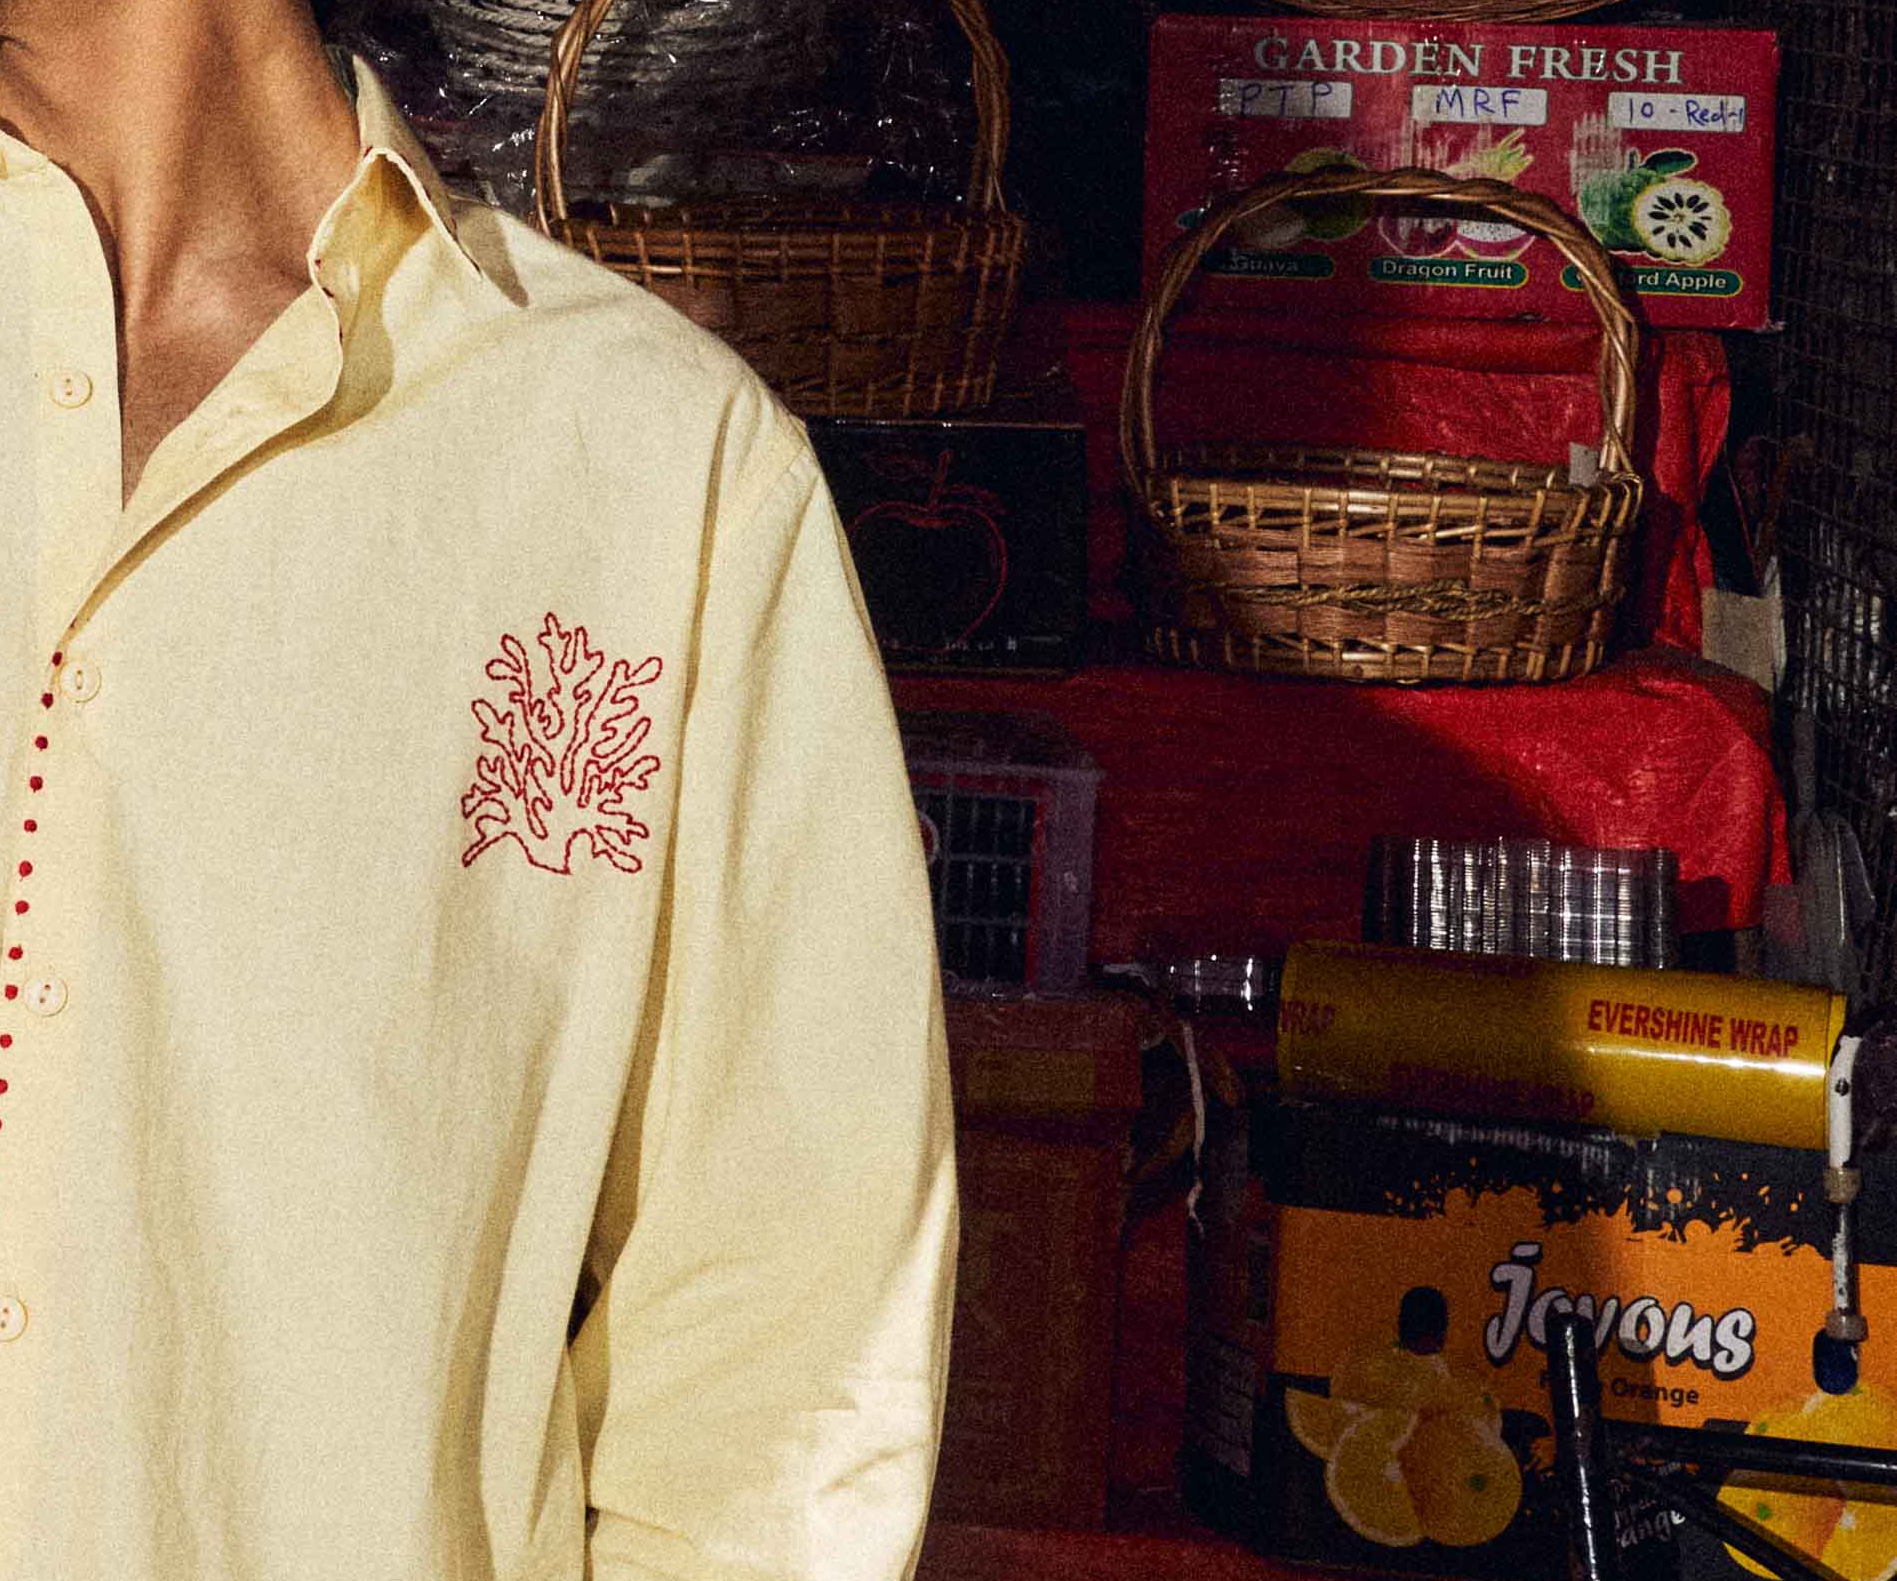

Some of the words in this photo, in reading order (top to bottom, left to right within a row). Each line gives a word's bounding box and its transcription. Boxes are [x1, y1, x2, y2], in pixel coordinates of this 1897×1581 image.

[1255, 37, 1486, 79] GARDEN
[1506, 44, 1685, 86] FRESH
[1381, 258, 1460, 284] Dragon
[1463, 260, 1515, 282] Fruit
[1665, 270, 1728, 293] Apple
[1588, 999, 1724, 1048] EVERSHINE
[1729, 1017, 1800, 1058] WRAP
[1610, 1378, 1700, 1407] Orange
